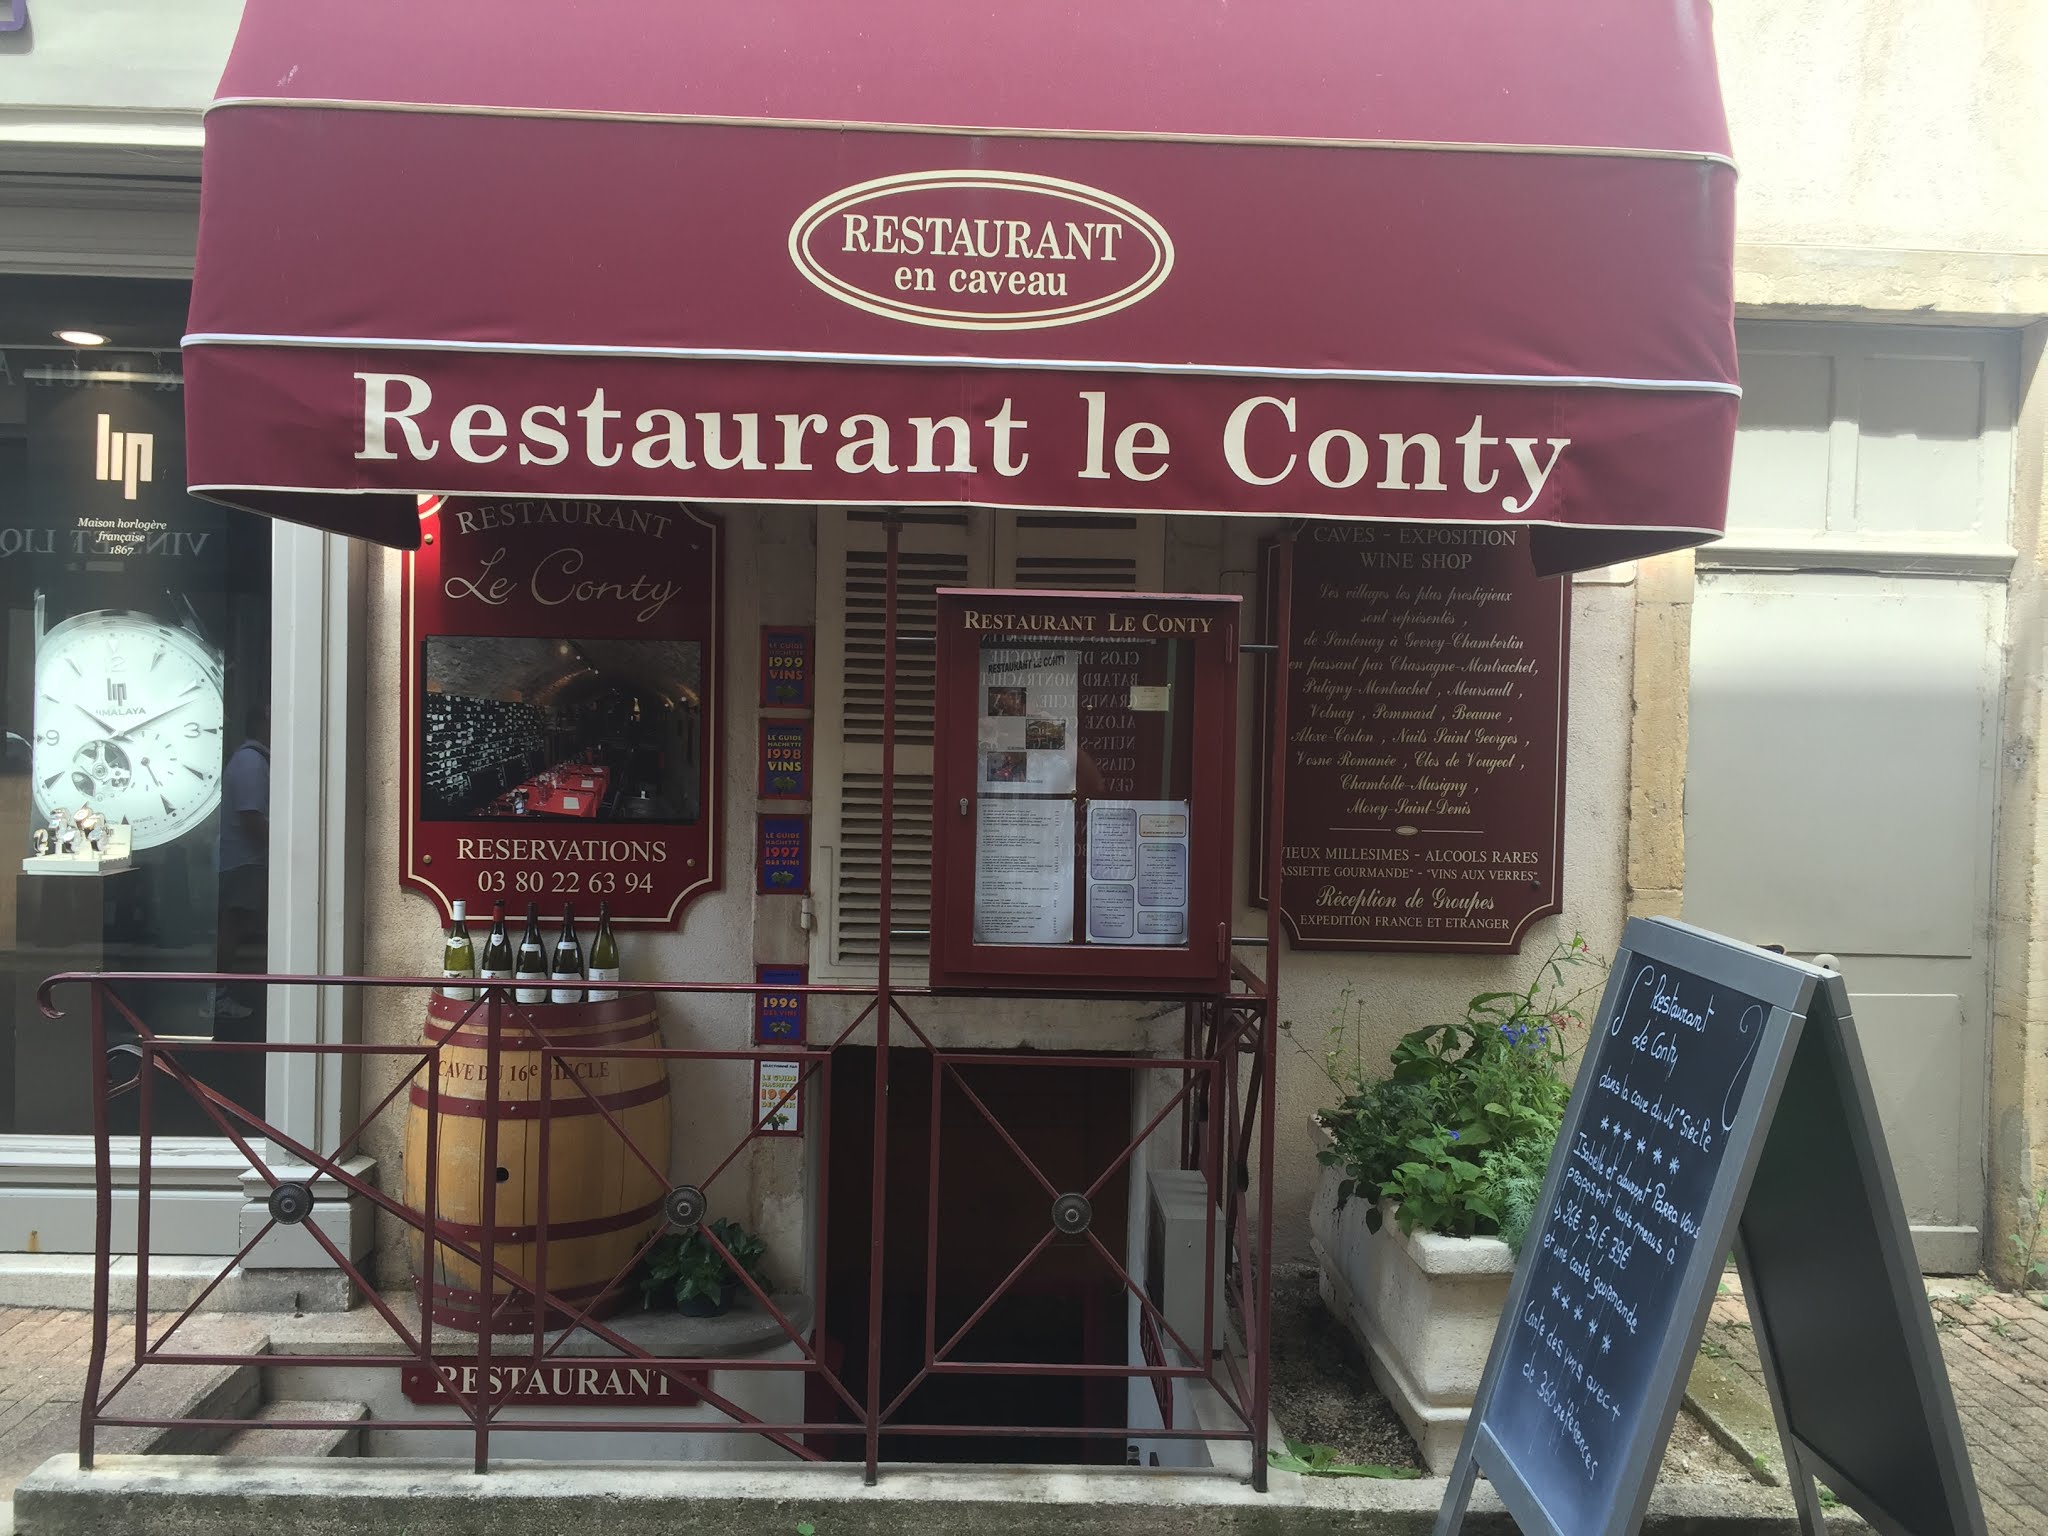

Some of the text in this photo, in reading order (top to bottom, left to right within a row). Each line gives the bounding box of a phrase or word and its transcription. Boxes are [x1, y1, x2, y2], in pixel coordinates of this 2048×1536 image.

[841, 213, 1123, 261] RESTAURANT
[894, 266, 1068, 296] en caveau
[353, 371, 1571, 513] Restaurant le Conty
[96, 413, 154, 500] lip
[77, 517, 167, 532] Maison horlogère
[455, 500, 672, 539] RESTAURANT
[95, 530, 146, 543] française
[1314, 527, 1517, 546] CAVES EXPOSITION
[109, 545, 134, 557] 1867
[1360, 552, 1473, 569] WINE SHOP
[444, 547, 682, 622] Le Conty
[1319, 584, 1512, 608] Les villages les plus prestigieux
[964, 610, 1213, 633] RESTAURANT LE CONTY
[1360, 609, 1456, 631] sont représentés
[1303, 629, 1524, 654] de Santenay à Gevrey-Chambertin
[768, 657, 804, 668] 1999
[769, 669, 803, 680] VINS
[987, 660, 1032, 675] RESTAURANT
[1307, 656, 1357, 676] passant
[1359, 658, 1384, 676] par
[1389, 655, 1538, 680] Chassagne-Montrachet,
[1302, 678, 1512, 703] Puligny-Montrachet Meursault
[1309, 703, 1502, 725] Volnay Pommard Beaune
[1290, 727, 1518, 749] Aloxe-Corton Nuits Saint Georges
[767, 749, 802, 760] 1998
[767, 761, 802, 772] VINS
[1297, 750, 1516, 774] Vosne Romanée Clos de Vougeot
[1340, 774, 1469, 798] Chambolle-Musigny
[1346, 798, 1472, 820] Morey-Saint-Denis
[456, 838, 668, 863] RESERVATIONS
[765, 847, 800, 858] 1997
[1325, 847, 1409, 861] MILLESIMES
[1425, 850, 1487, 863] ALCOOLS
[1491, 851, 1539, 864] RARES
[477, 870, 654, 894] 03 80 22 63 94
[1460, 869, 1486, 881] AUX
[1316, 885, 1495, 918] Réception de Groupes
[1300, 914, 1510, 930] EXPEDITION FRANCE ET ETRANGER
[763, 996, 798, 1009] 1996
[1650, 974, 1715, 1033] Restaurant
[1650, 1031, 1679, 1079] Conty
[437, 1060, 474, 1081] CAVE
[510, 1063, 539, 1082] 16e
[550, 1060, 610, 1081] IECLE
[772, 1074, 797, 1082] GUIDE
[1599, 1065, 1620, 1095] dans
[1630, 1089, 1649, 1114] cave
[1650, 1093, 1663, 1121] du
[1573, 1131, 1607, 1176] Isabelle
[1606, 1152, 1618, 1181] et
[1612, 1192, 1633, 1229] leurs
[1632, 1221, 1663, 1255] menus
[1543, 1230, 1556, 1249] et
[1553, 1243, 1568, 1264] une
[1568, 1252, 1592, 1285] carte
[1608, 1236, 1633, 1270] 39€
[1522, 1351, 1537, 1384] de
[1546, 1322, 1564, 1358] des
[1585, 1375, 1610, 1410] avec
[433, 1366, 671, 1397] RESTAURANT
